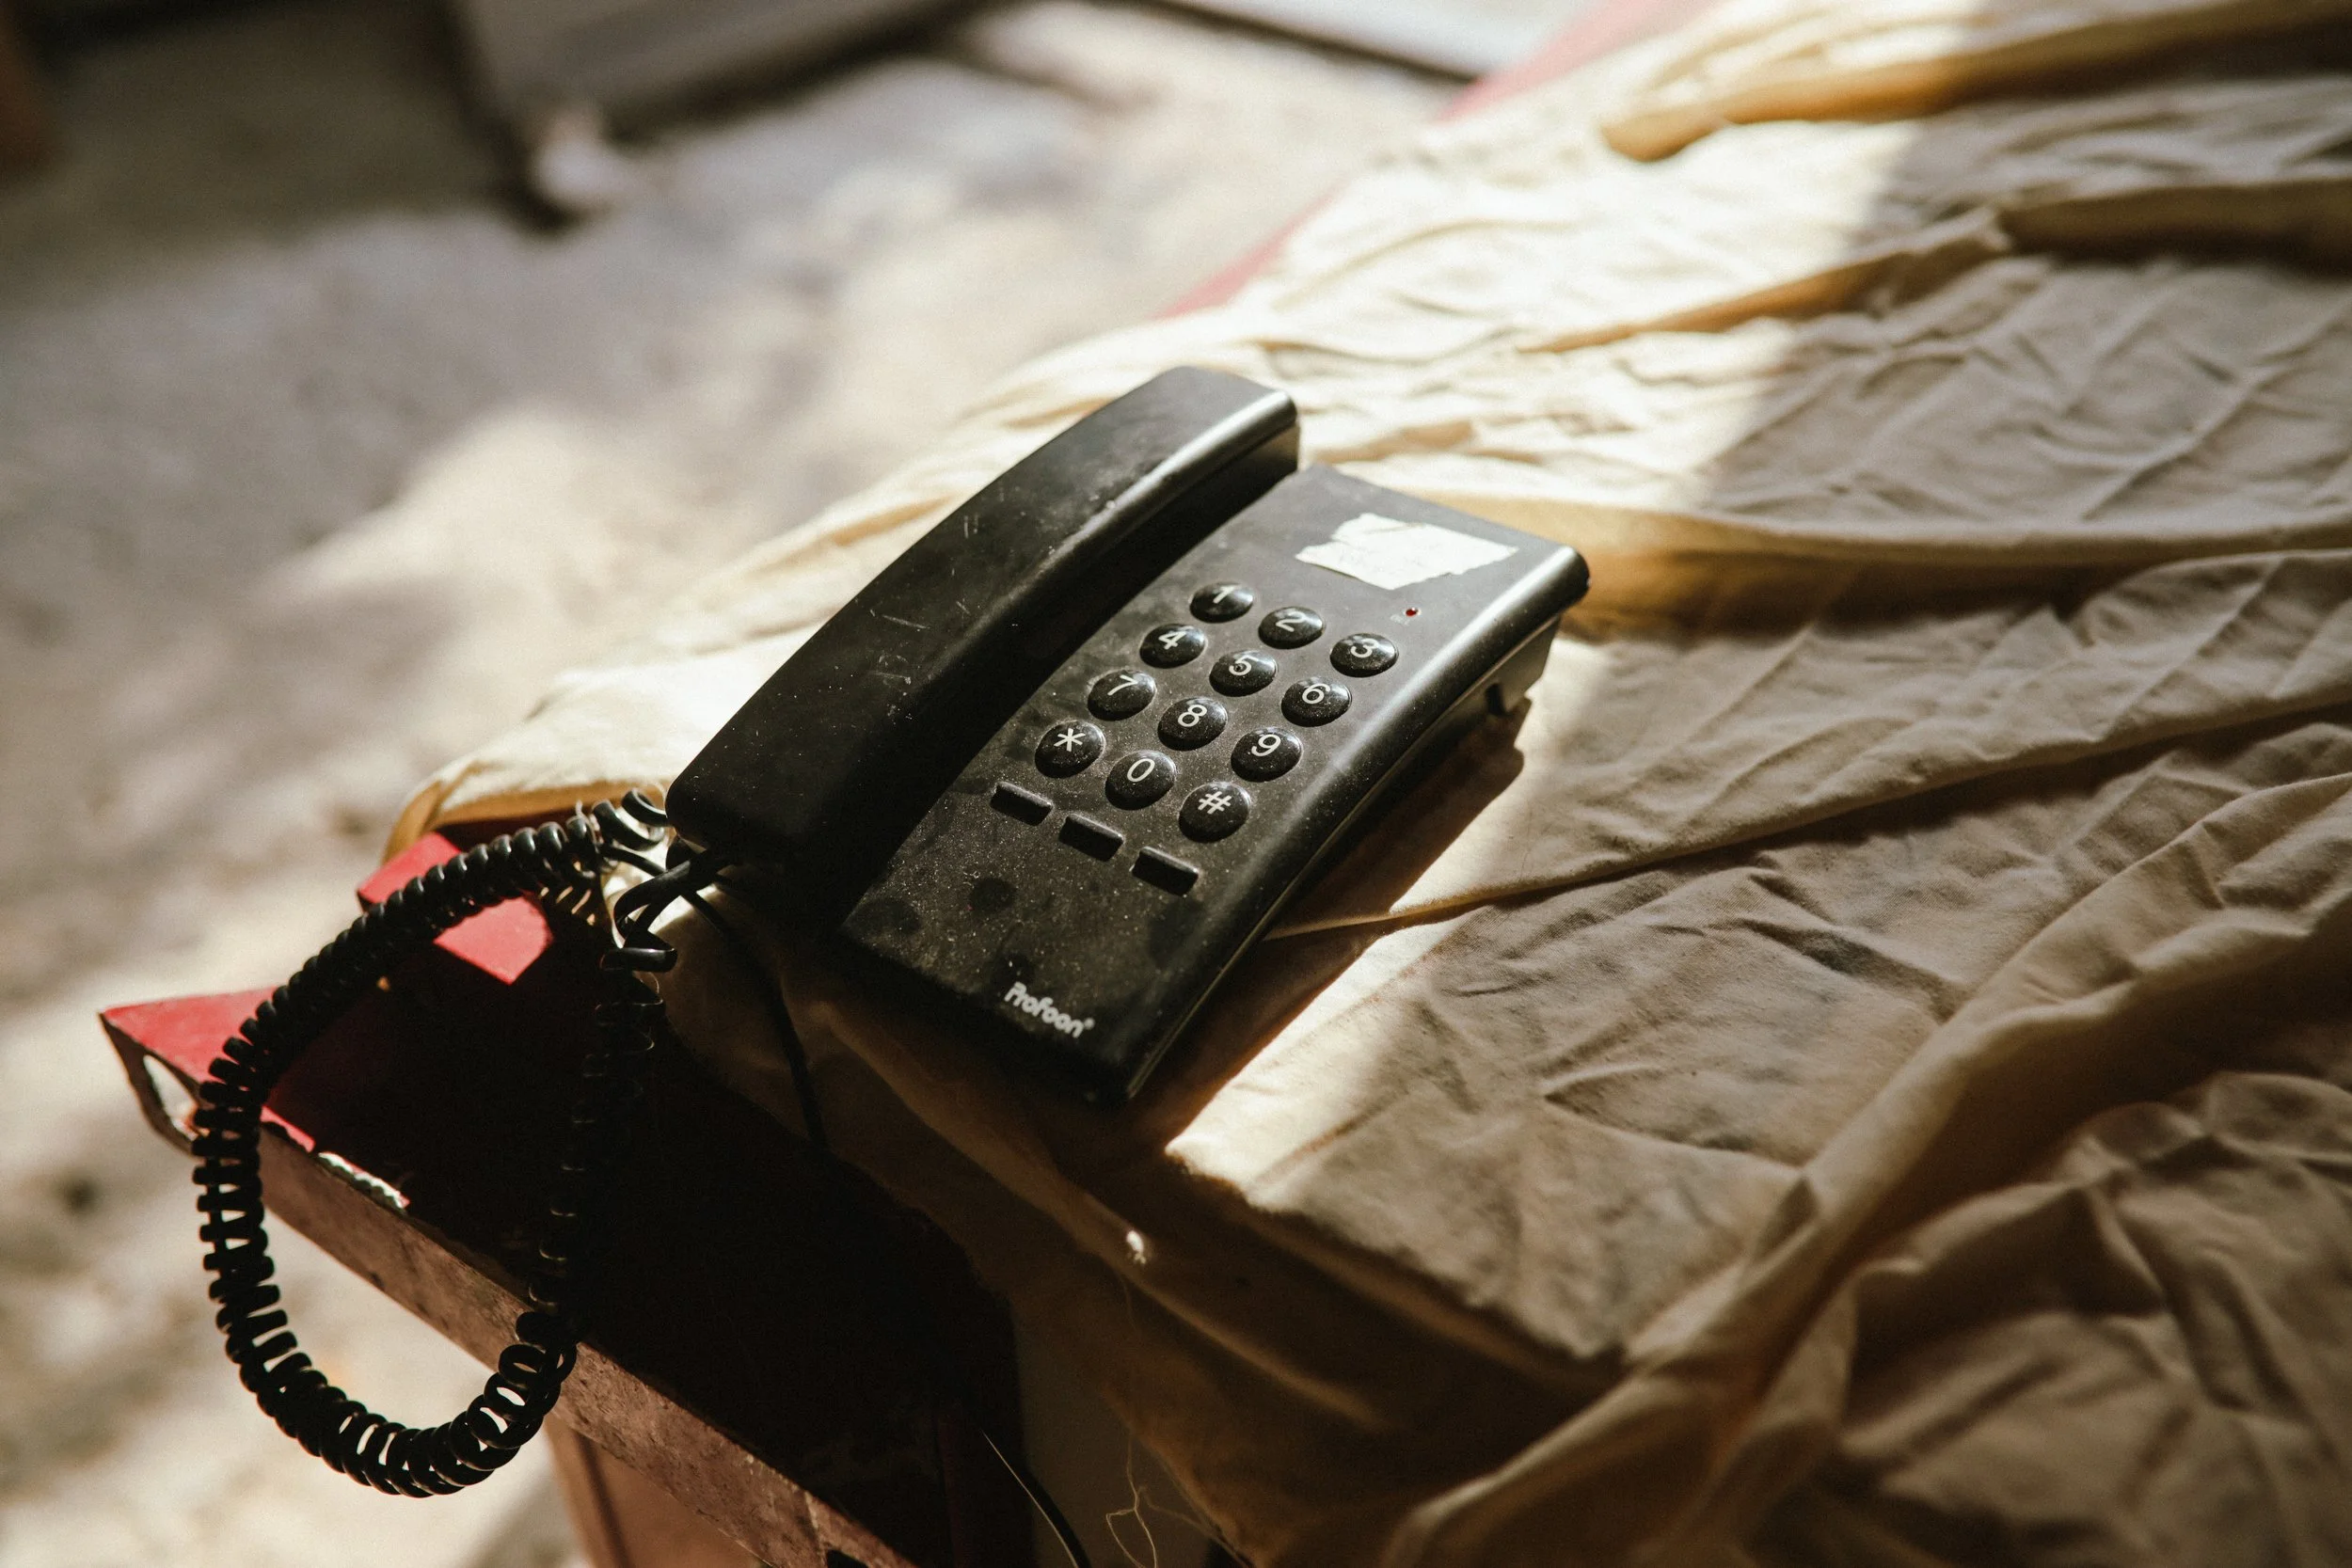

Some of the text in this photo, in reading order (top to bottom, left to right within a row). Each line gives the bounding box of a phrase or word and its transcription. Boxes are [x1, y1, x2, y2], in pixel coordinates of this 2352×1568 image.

[1214, 583, 1379, 658] 1 2 3
[1158, 629, 1330, 705] 4 5 6
[1107, 674, 1281, 757] 7 8 9
[1126, 758, 1155, 783] 0
[1198, 792, 1232, 815] #
